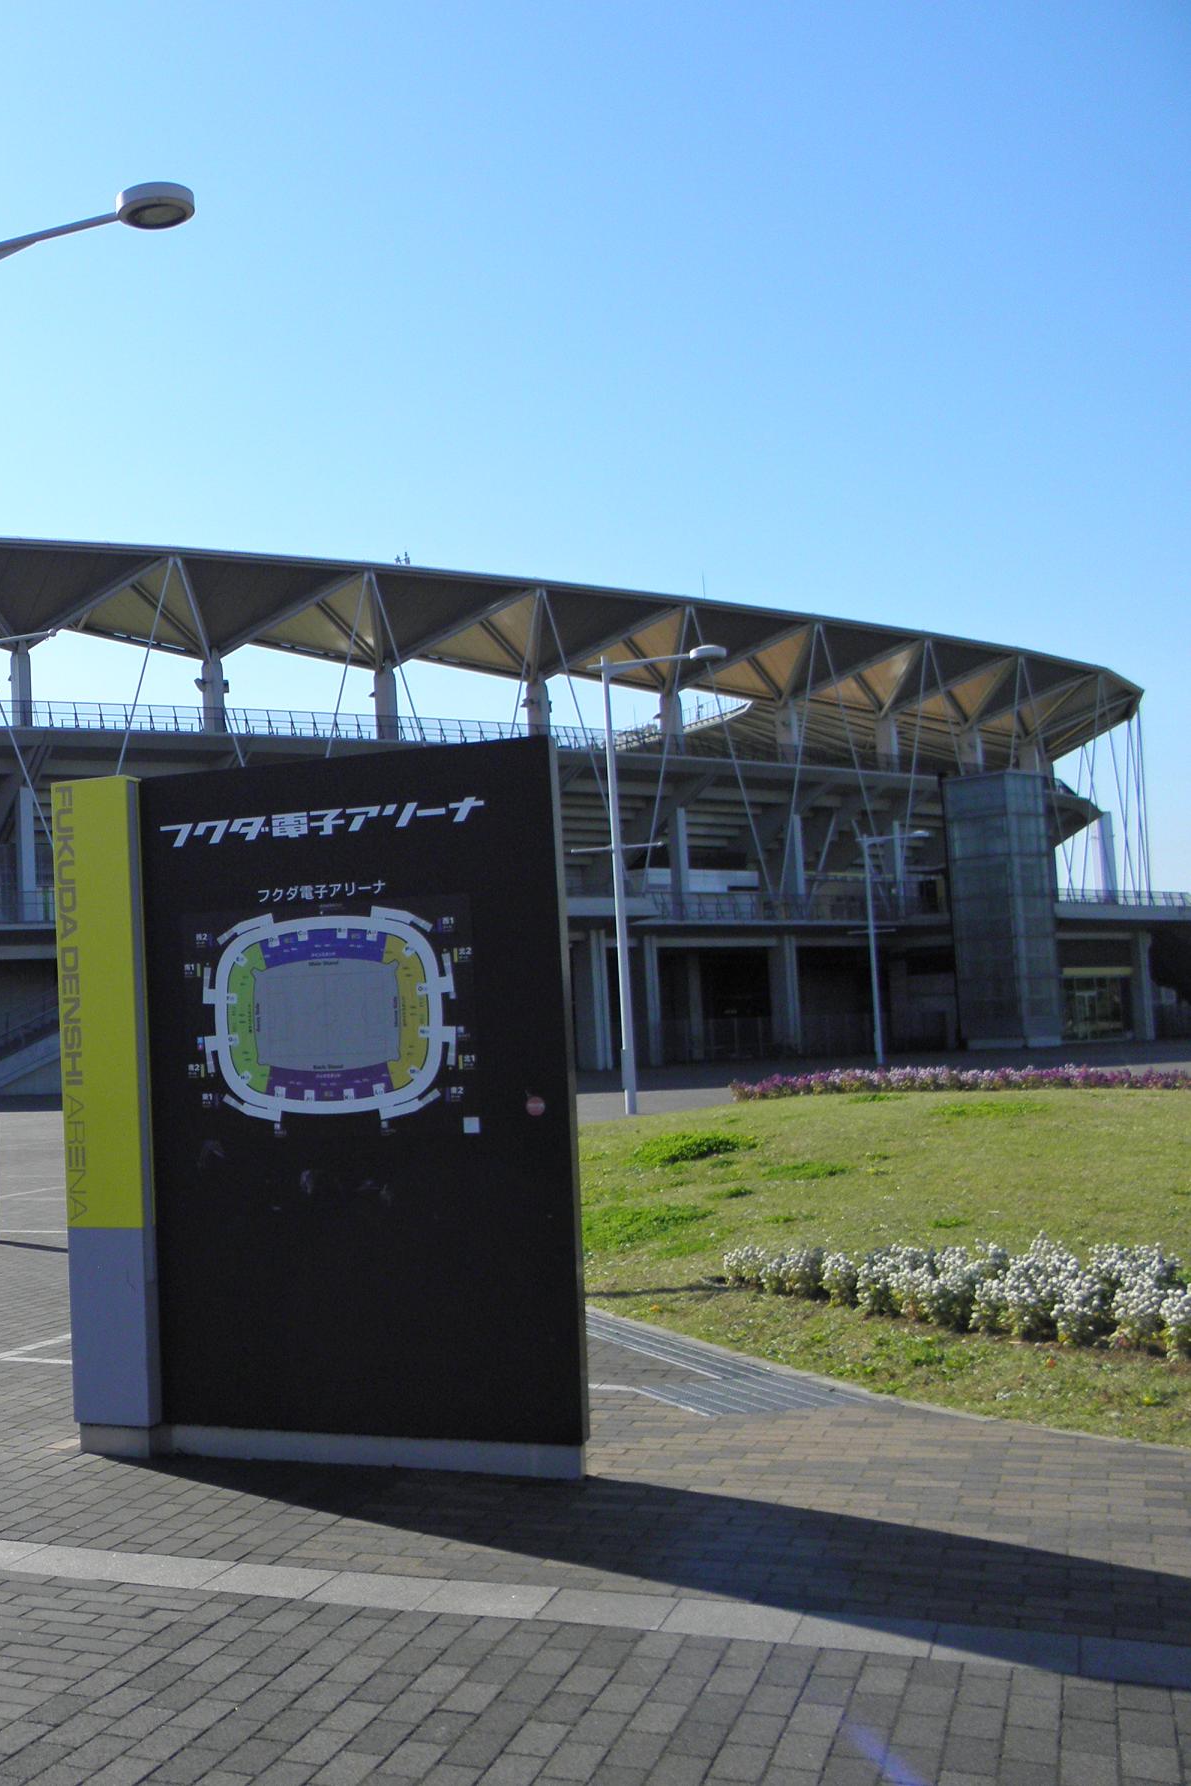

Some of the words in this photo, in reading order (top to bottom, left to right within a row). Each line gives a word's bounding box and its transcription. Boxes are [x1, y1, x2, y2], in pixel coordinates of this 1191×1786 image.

[55, 786, 78, 941] FUKUDA
[160, 796, 485, 848] フクダ電子アリーナ
[257, 880, 386, 903] フクダ電子アリーナ
[61, 946, 84, 1086] DENSHI
[65, 1094, 88, 1222] ARENA
